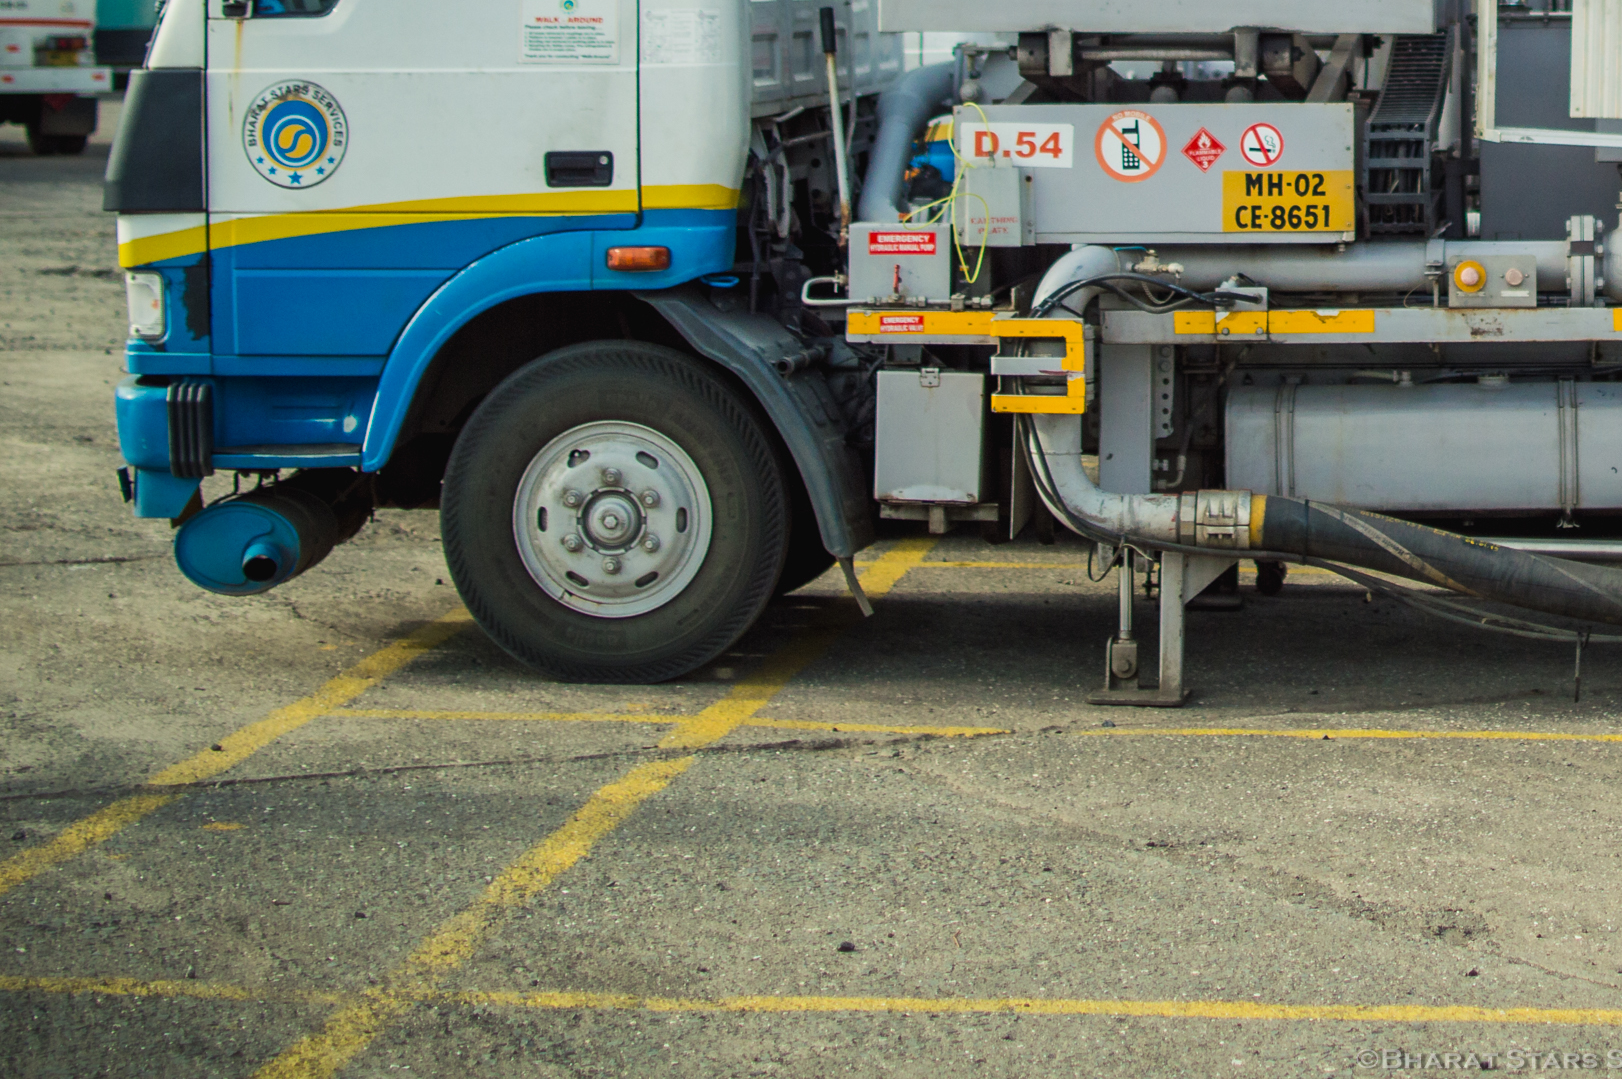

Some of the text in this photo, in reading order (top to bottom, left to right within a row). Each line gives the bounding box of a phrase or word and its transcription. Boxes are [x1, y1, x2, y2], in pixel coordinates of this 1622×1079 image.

[270, 84, 310, 100] STARS
[312, 88, 344, 147] SERVICES
[1124, 110, 1152, 122] MOBILE
[974, 130, 1063, 159] D.54
[1188, 148, 1222, 157] FLAMMABLE
[1202, 161, 1209, 169] 3
[1245, 173, 1326, 197] MH-02
[1235, 204, 1330, 230] CE-8651
[877, 235, 930, 243] EMERGENCY
